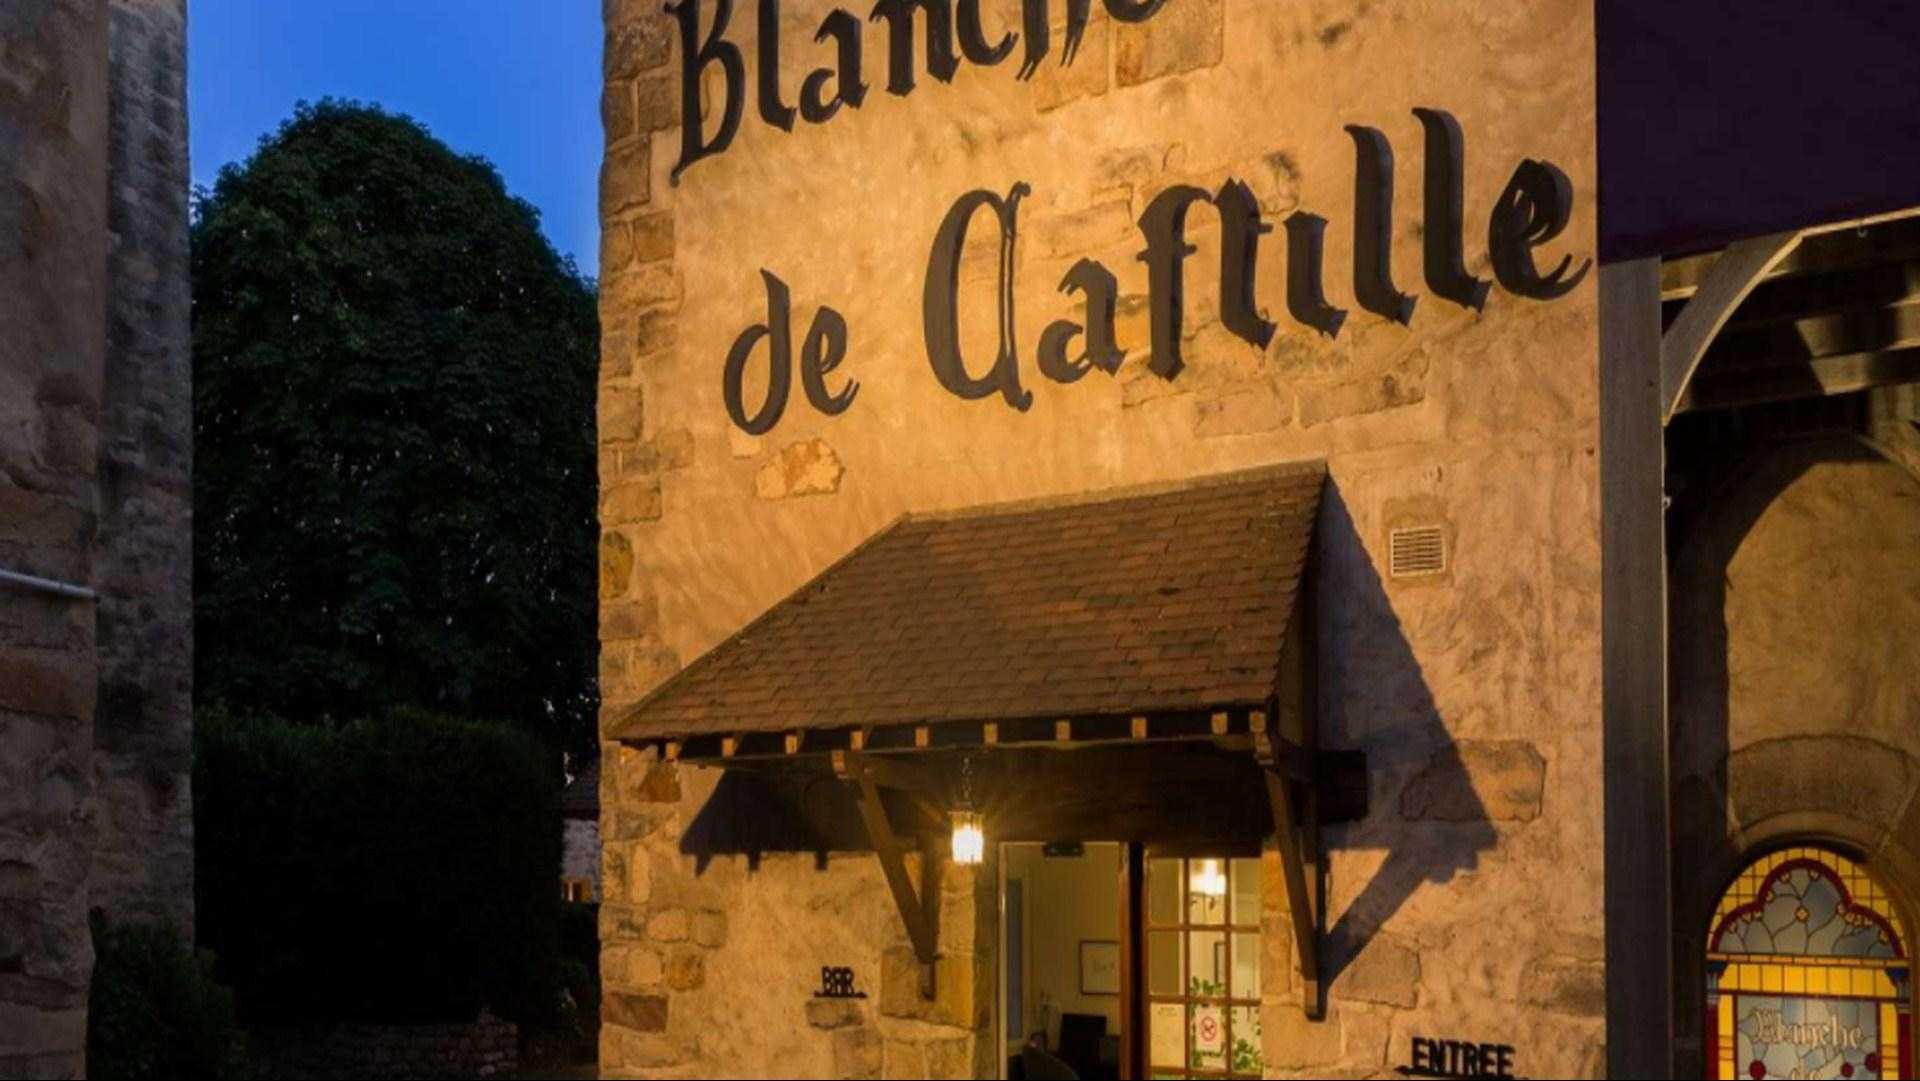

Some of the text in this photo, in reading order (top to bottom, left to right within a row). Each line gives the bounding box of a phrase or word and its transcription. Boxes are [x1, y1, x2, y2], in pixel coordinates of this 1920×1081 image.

[664, 0, 1168, 187] Blanc
[723, 267, 859, 435] de
[822, 966, 855, 995] BAR
[1412, 1037, 1516, 1079] ENTREE
